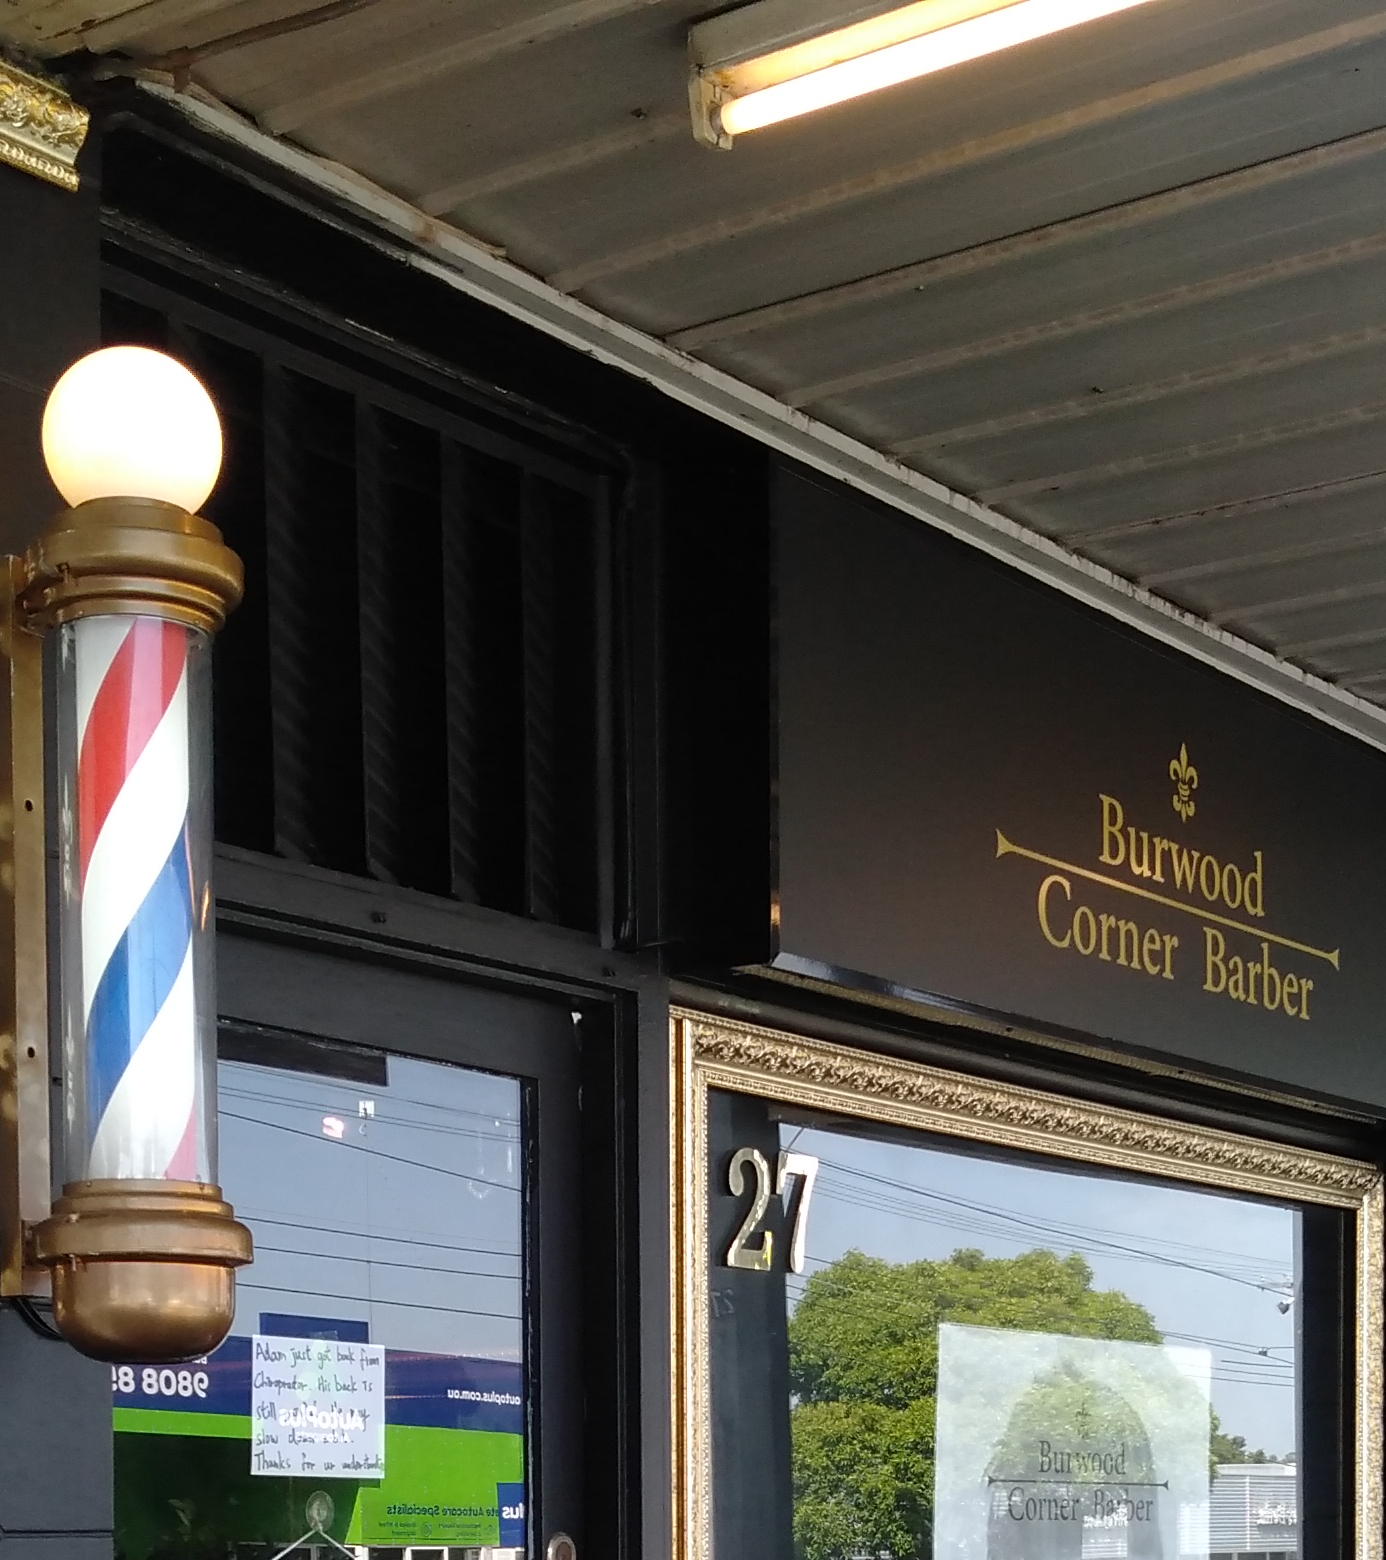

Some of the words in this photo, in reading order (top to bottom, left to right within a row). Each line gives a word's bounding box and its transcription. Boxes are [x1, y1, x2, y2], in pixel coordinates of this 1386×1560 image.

[1099, 793, 1264, 917] Burwood
[1038, 874, 1179, 980] Corner
[1203, 926, 1313, 1021] Barber
[726, 1147, 819, 1274] 27
[256, 1342, 287, 1361] Adam
[290, 1345, 312, 1368] just
[317, 1346, 332, 1369] got
[336, 1344, 356, 1364] back
[317, 1375, 331, 1392] His
[334, 1374, 358, 1393] back
[256, 1401, 277, 1421] still
[256, 1429, 279, 1446] slow
[254, 1451, 291, 1471] Thanks
[301, 1452, 316, 1471] for
[1038, 1440, 1127, 1475] Burwood
[1008, 1486, 1080, 1522] Corner
[1093, 1488, 1154, 1522] Barber
